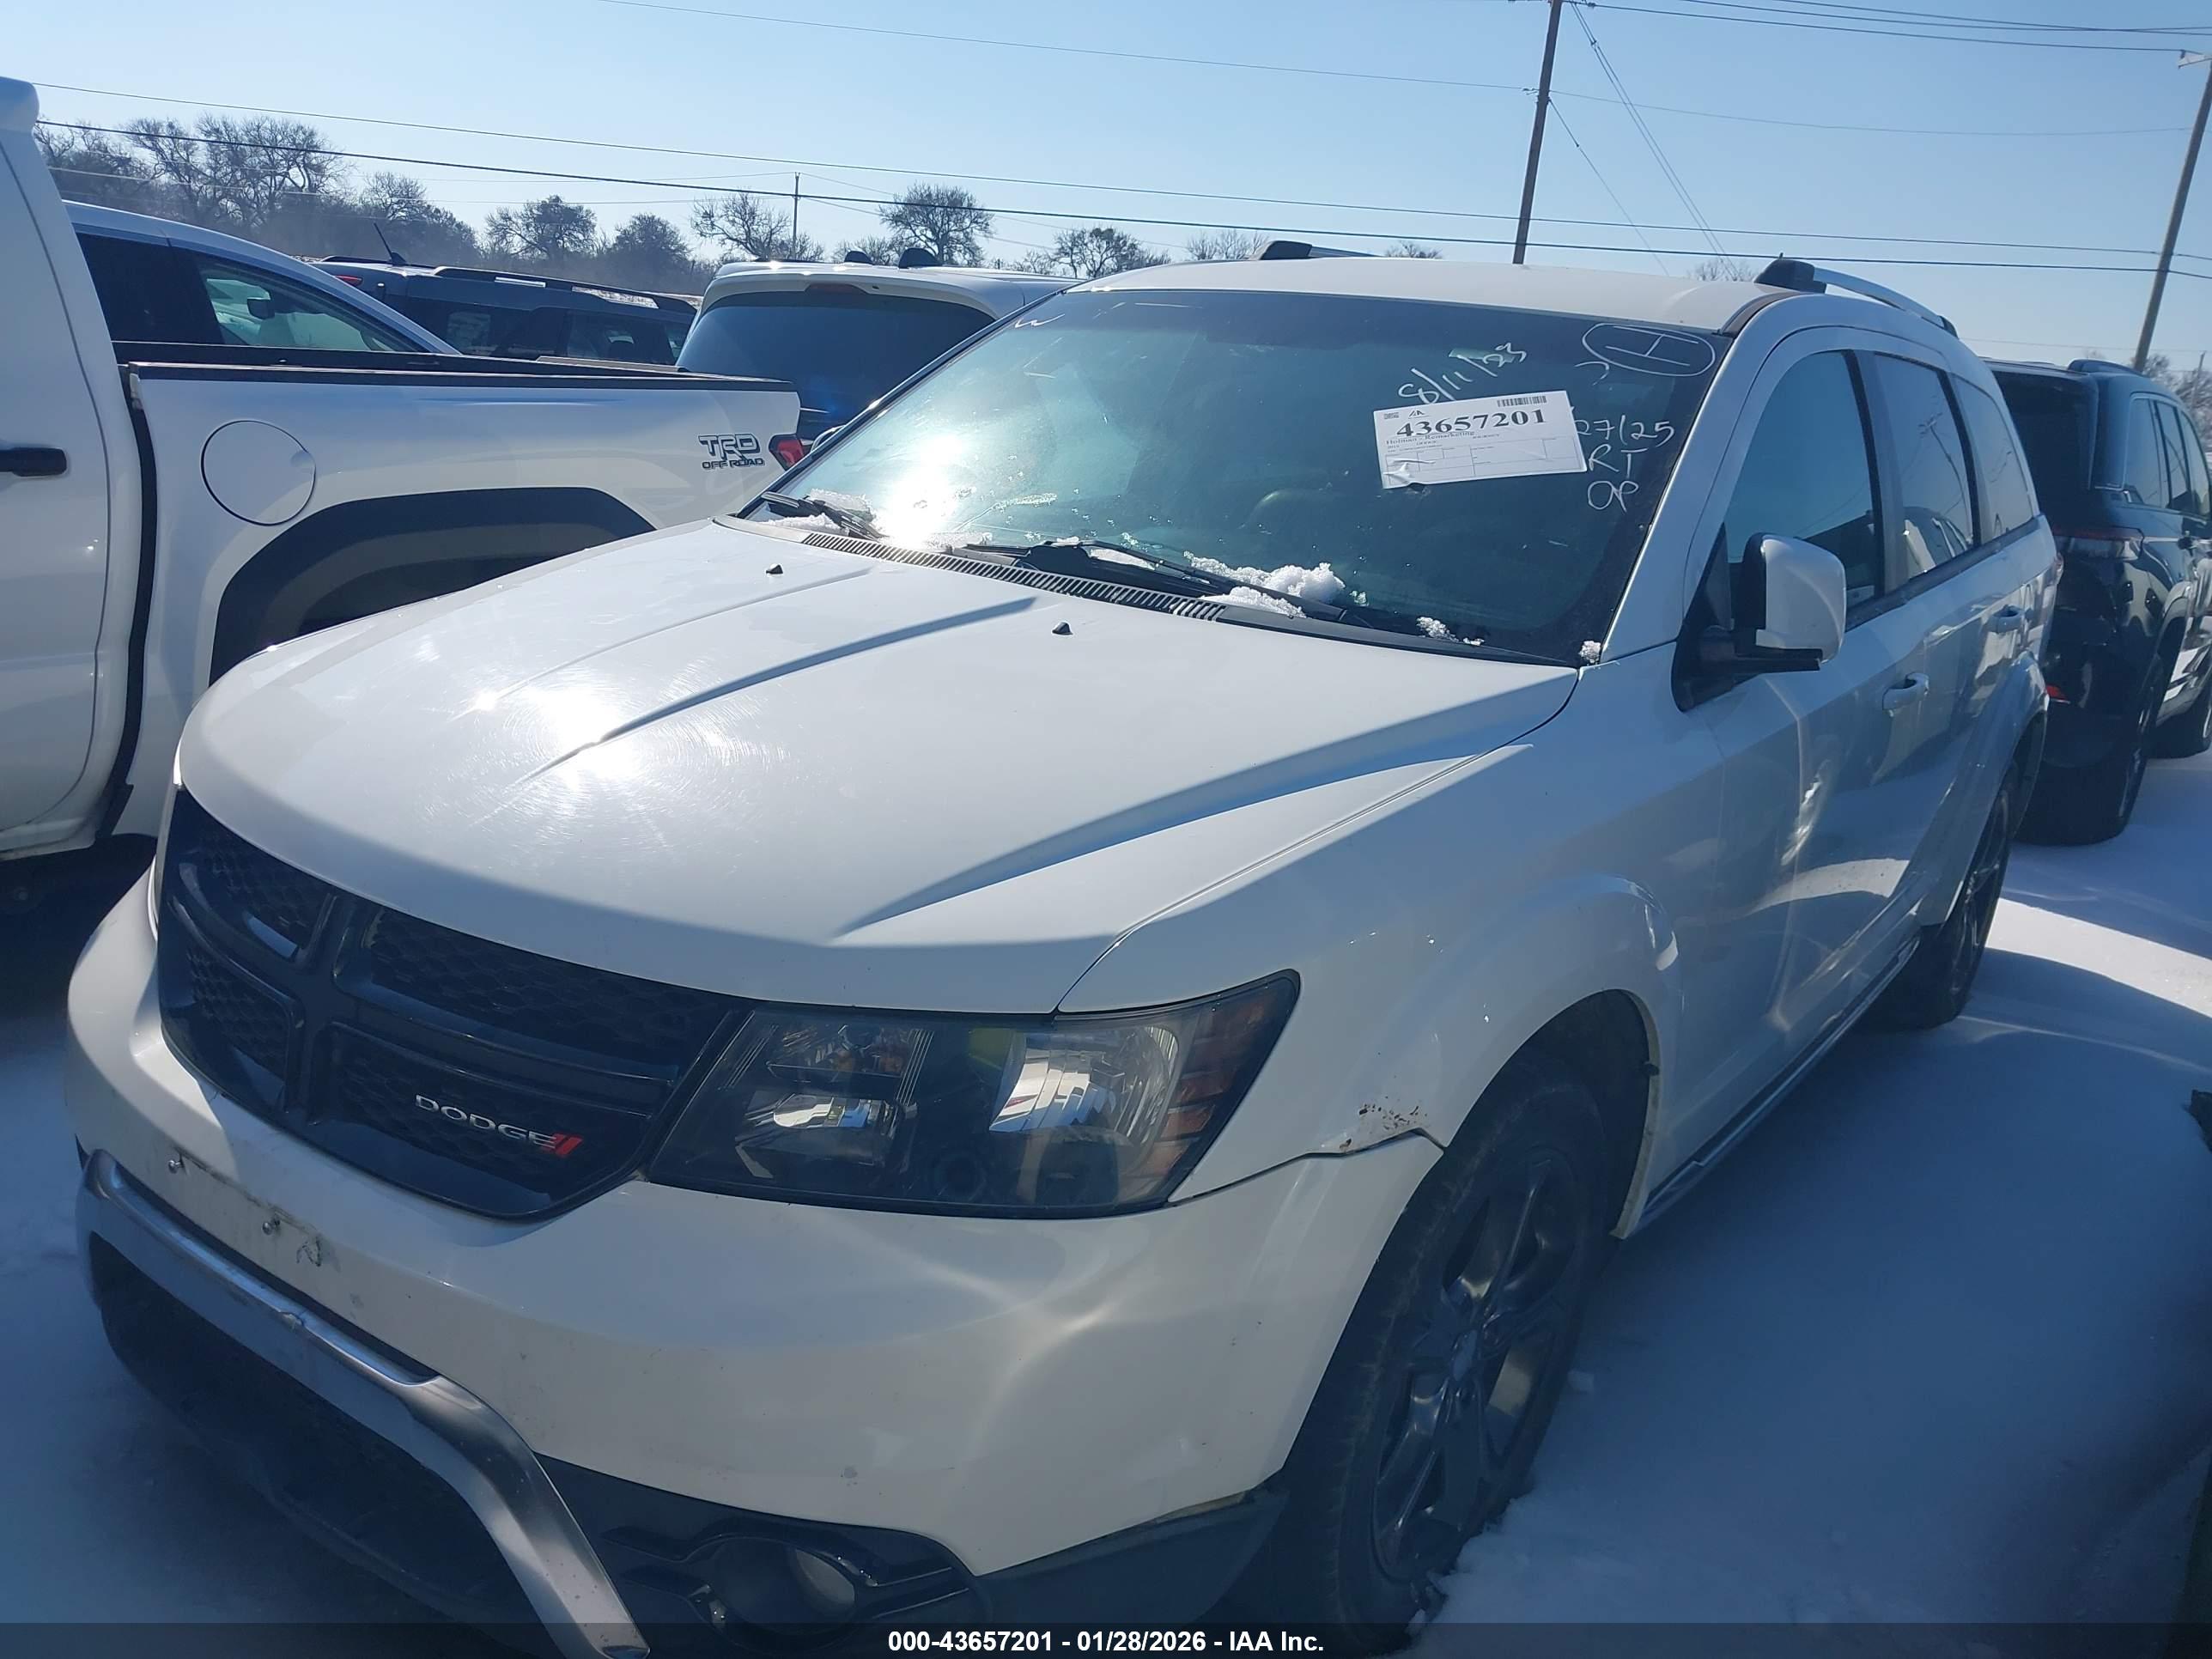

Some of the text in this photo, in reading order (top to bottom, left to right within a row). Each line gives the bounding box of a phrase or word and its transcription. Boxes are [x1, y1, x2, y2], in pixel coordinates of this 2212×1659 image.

[1396, 409, 1547, 437] 43657201
[698, 433, 761, 461] TRD
[702, 457, 765, 470] OFF ROAD
[415, 1093, 558, 1151] DODGE
